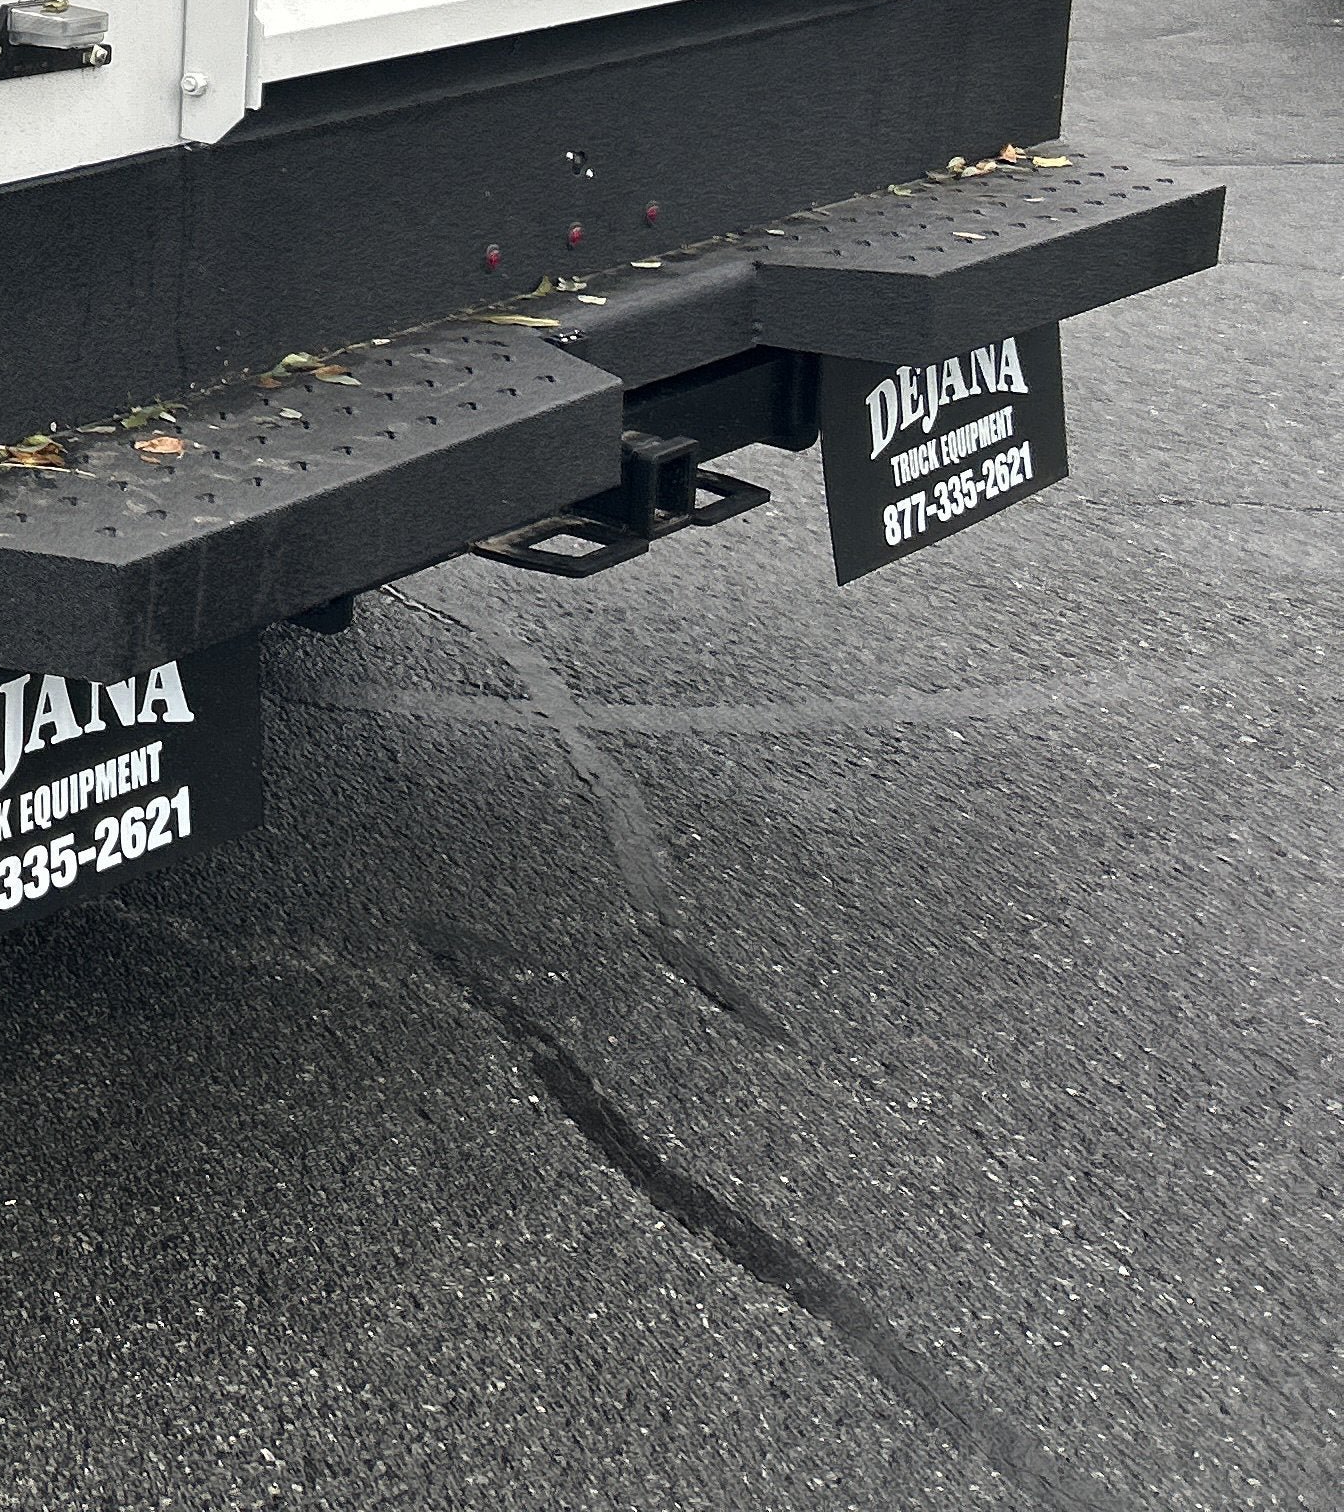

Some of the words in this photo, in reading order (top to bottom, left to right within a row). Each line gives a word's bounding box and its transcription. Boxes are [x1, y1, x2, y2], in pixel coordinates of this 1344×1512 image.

[865, 336, 1029, 460] DEJANA
[890, 438, 940, 488] TRUCK
[940, 405, 1014, 465] EQUIPMENT
[883, 441, 1034, 546] 877-335-2621
[19, 740, 163, 834] EQUIPMENT
